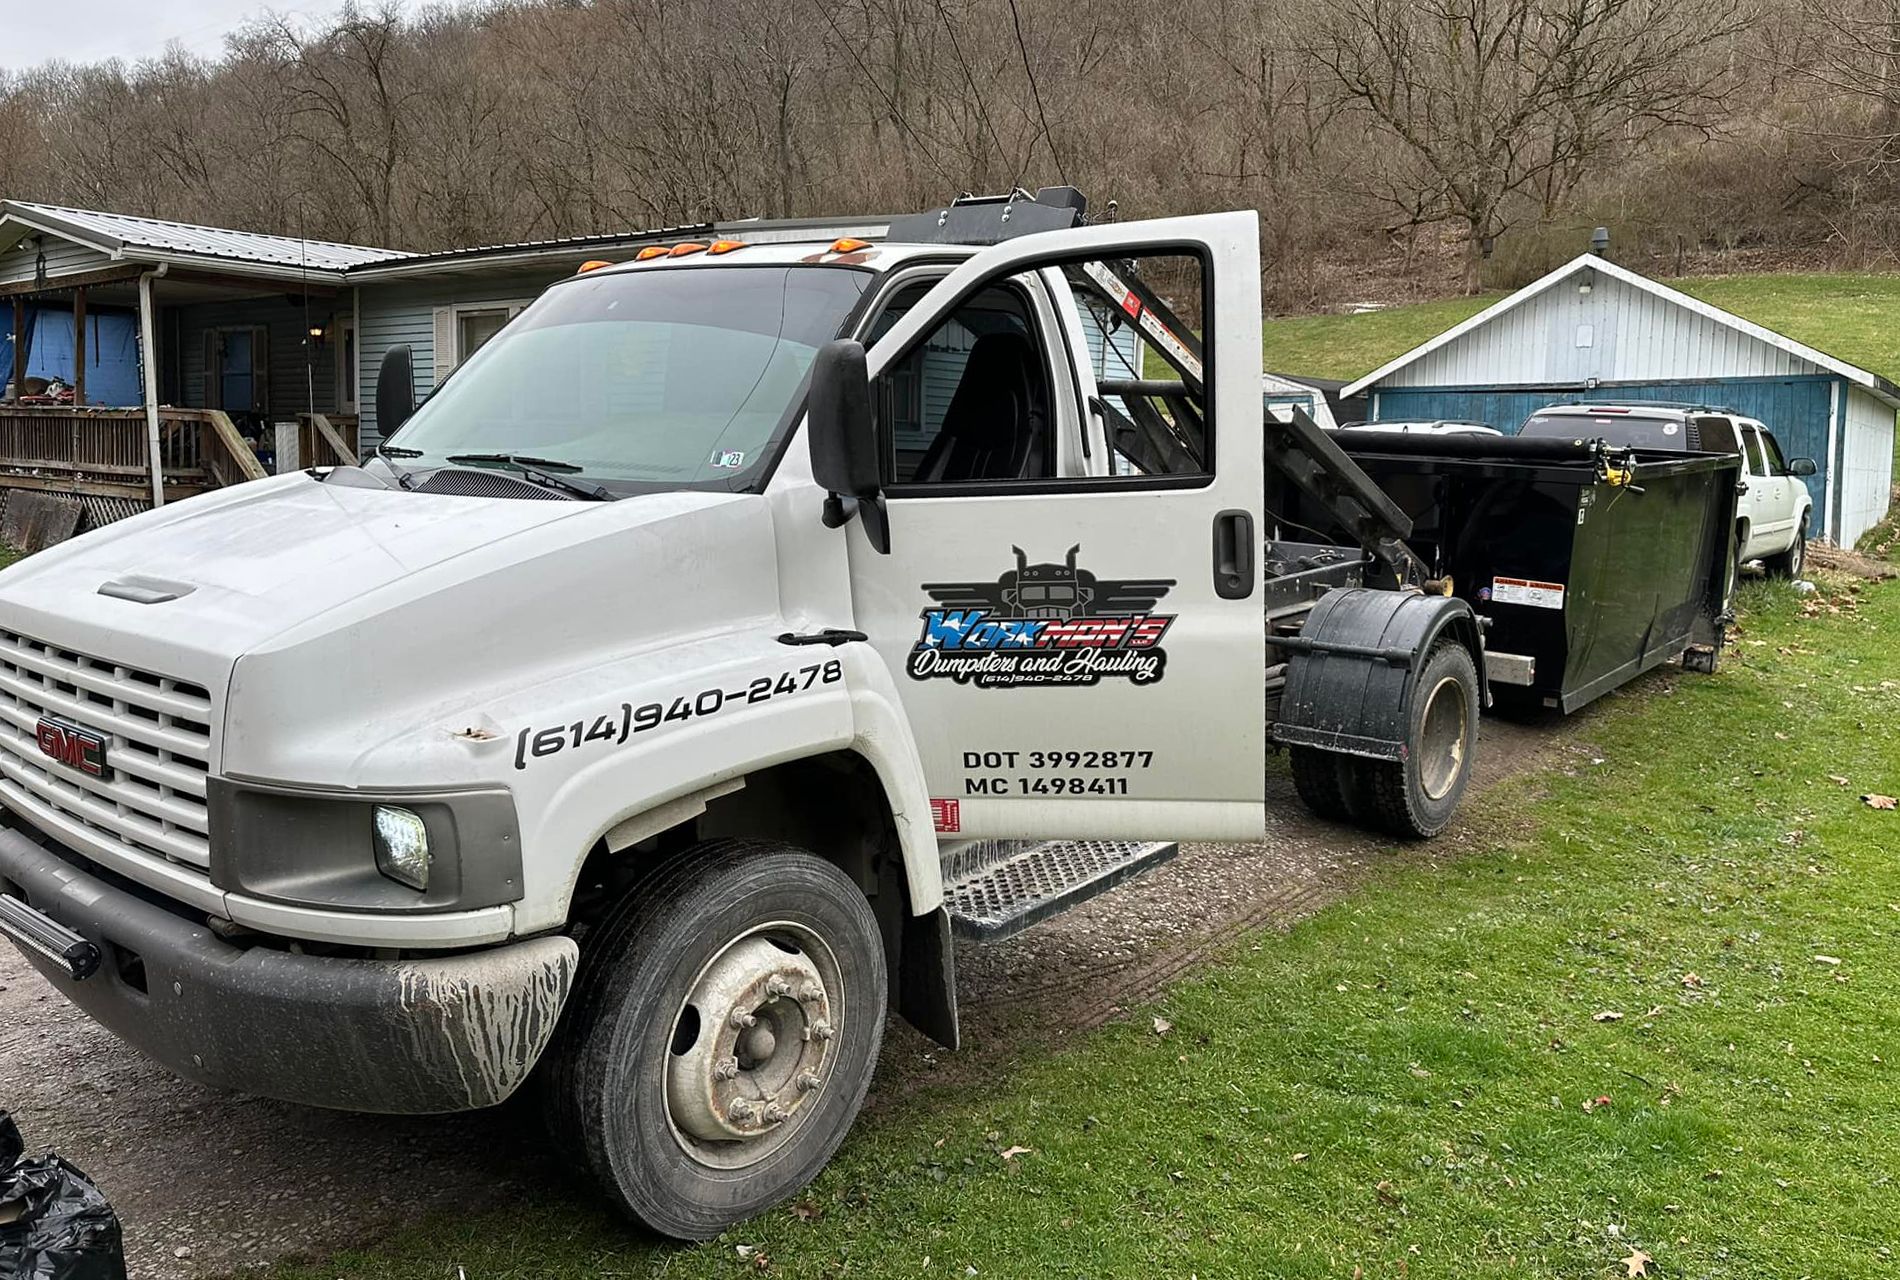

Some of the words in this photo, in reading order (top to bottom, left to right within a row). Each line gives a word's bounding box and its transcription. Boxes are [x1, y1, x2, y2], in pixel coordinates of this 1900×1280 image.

[913, 648, 1019, 679] Dumpsters
[1020, 652, 1063, 673] and
[1065, 647, 1159, 680] Hauling
[981, 674, 1093, 683] (614)940-2478
[514, 659, 843, 770] (614)940-2478
[36, 719, 102, 776] GMC
[963, 751, 1020, 769] DOT
[1029, 751, 1154, 769] 3992877
[965, 777, 1009, 795] MC
[1018, 777, 1128, 795] 1498411
